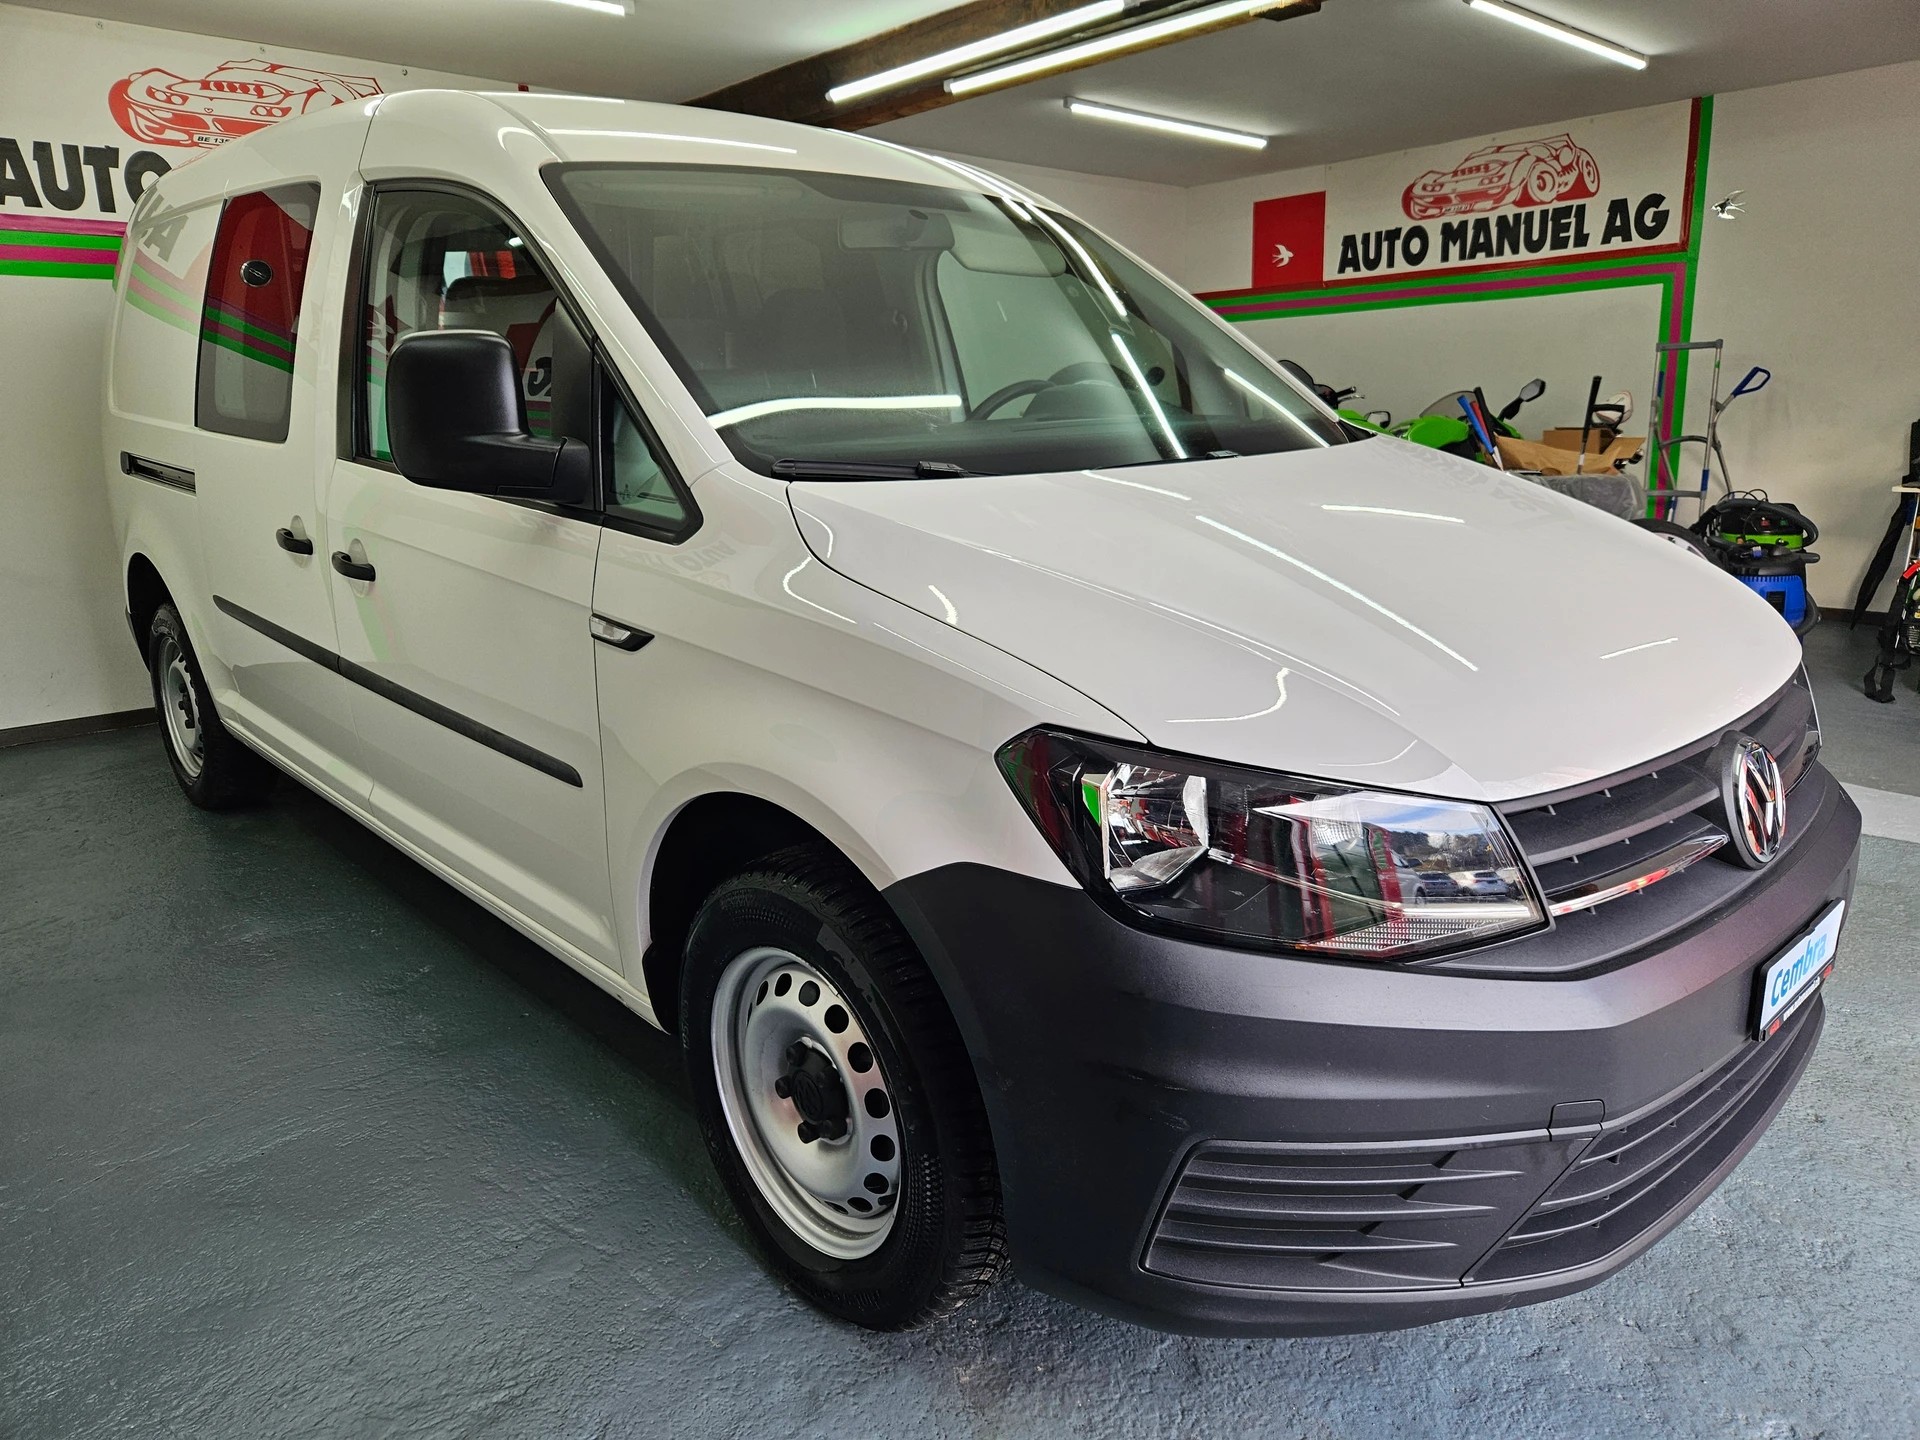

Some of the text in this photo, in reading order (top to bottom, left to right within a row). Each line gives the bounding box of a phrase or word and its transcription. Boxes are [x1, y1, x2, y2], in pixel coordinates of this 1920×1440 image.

[0, 137, 172, 213] AUTO
[1337, 193, 1670, 274] AUTO MANUEL AG
[1770, 933, 1827, 1007] Cembra
